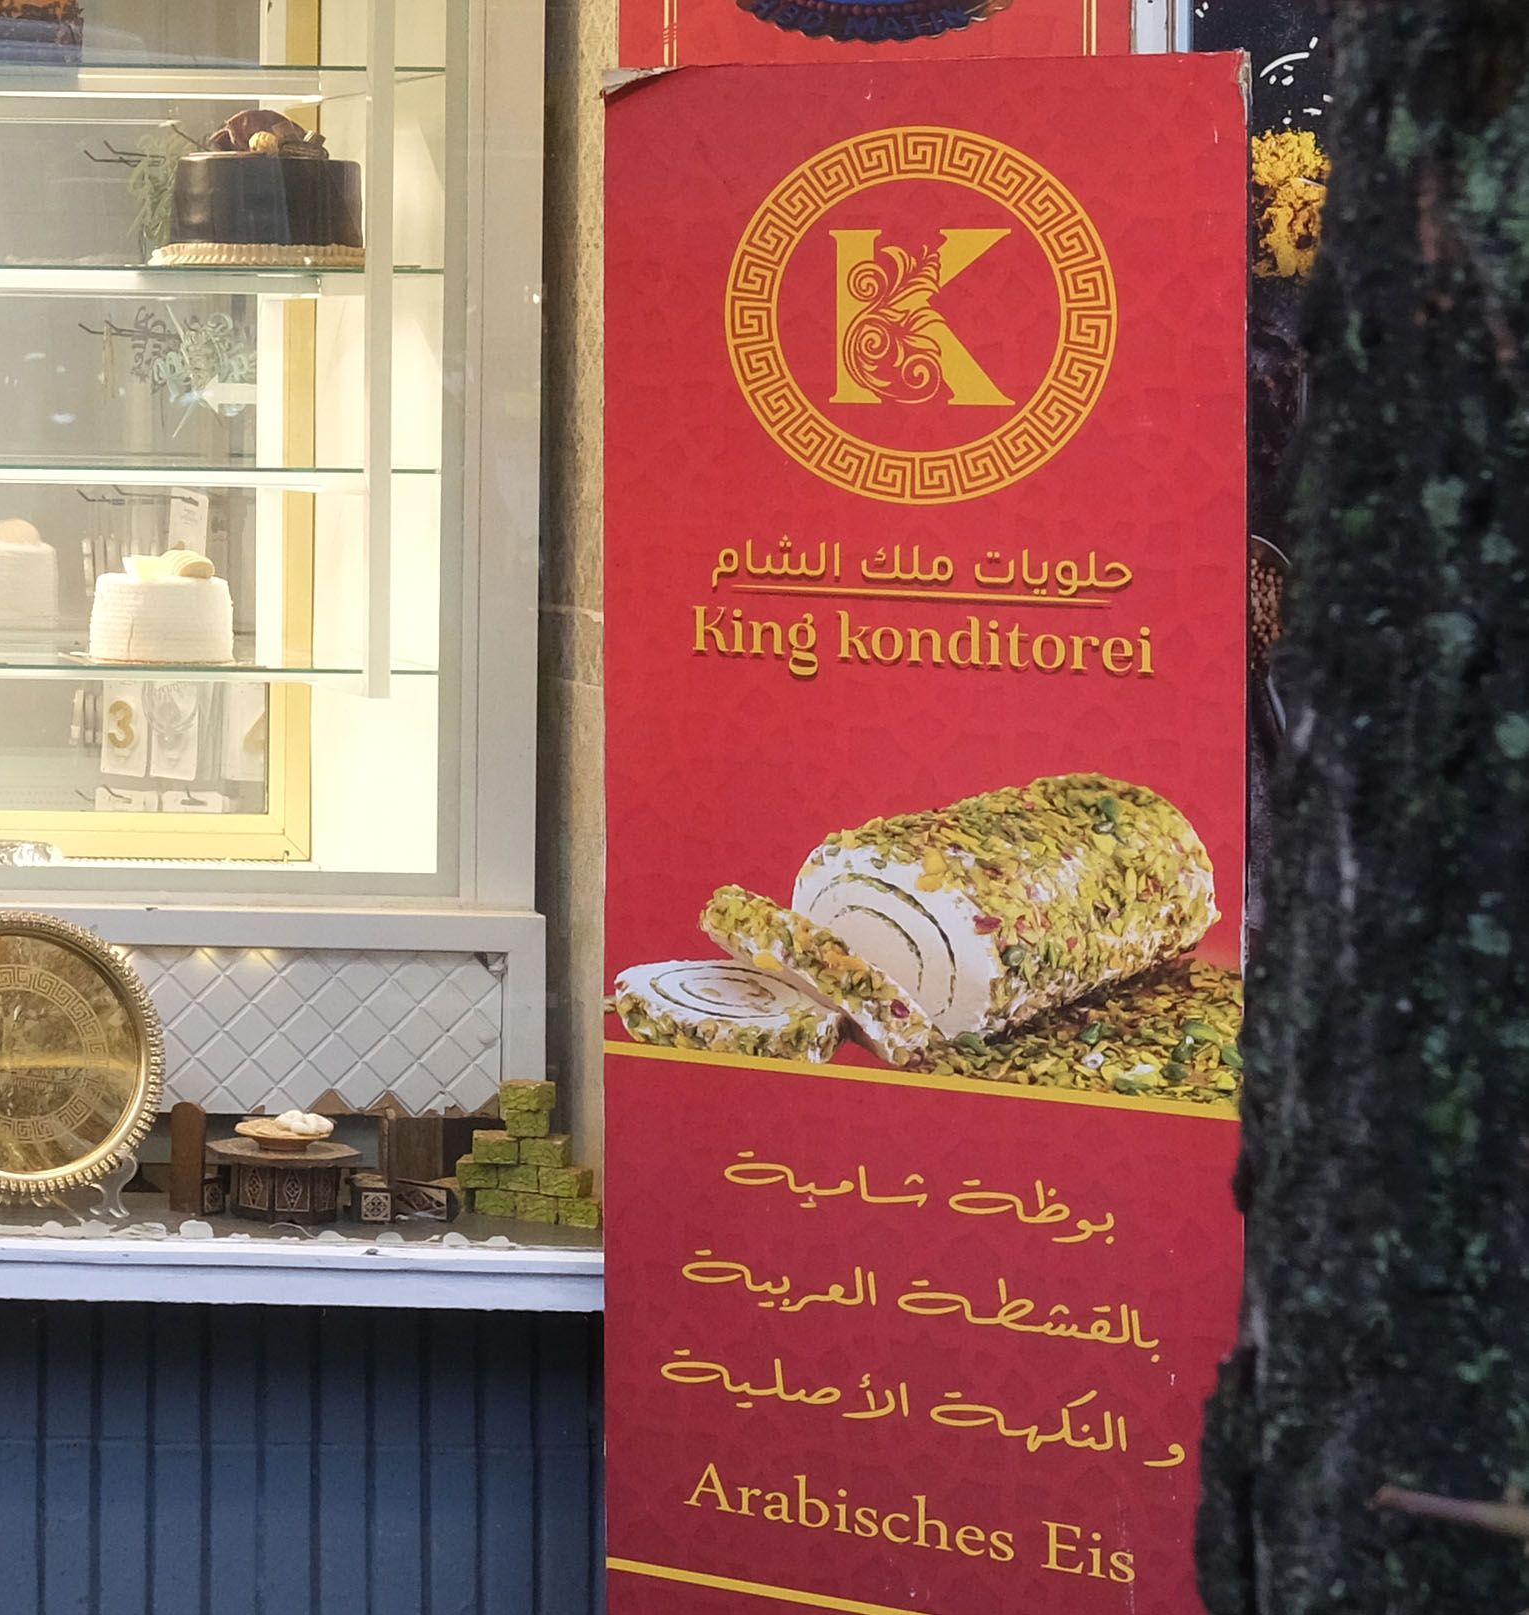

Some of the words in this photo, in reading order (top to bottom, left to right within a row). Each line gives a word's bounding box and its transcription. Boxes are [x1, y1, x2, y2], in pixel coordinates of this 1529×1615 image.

[829, 228, 1016, 405] K
[712, 535, 841, 587] الشام
[860, 544, 954, 581] ملك
[974, 548, 1133, 596] حلويات
[692, 604, 819, 676] King
[837, 610, 1155, 674] konditorei
[724, 1151, 928, 1208] شامية
[948, 1180, 1115, 1244] بوظة
[681, 1250, 877, 1311] العربية
[897, 1278, 1160, 1362] بالقشطة
[660, 1350, 909, 1418] الأصلية
[930, 1390, 1128, 1451] النكهة
[1143, 1443, 1186, 1467] و
[684, 1463, 1016, 1562] Arabisches
[1041, 1521, 1137, 1584] Eis
